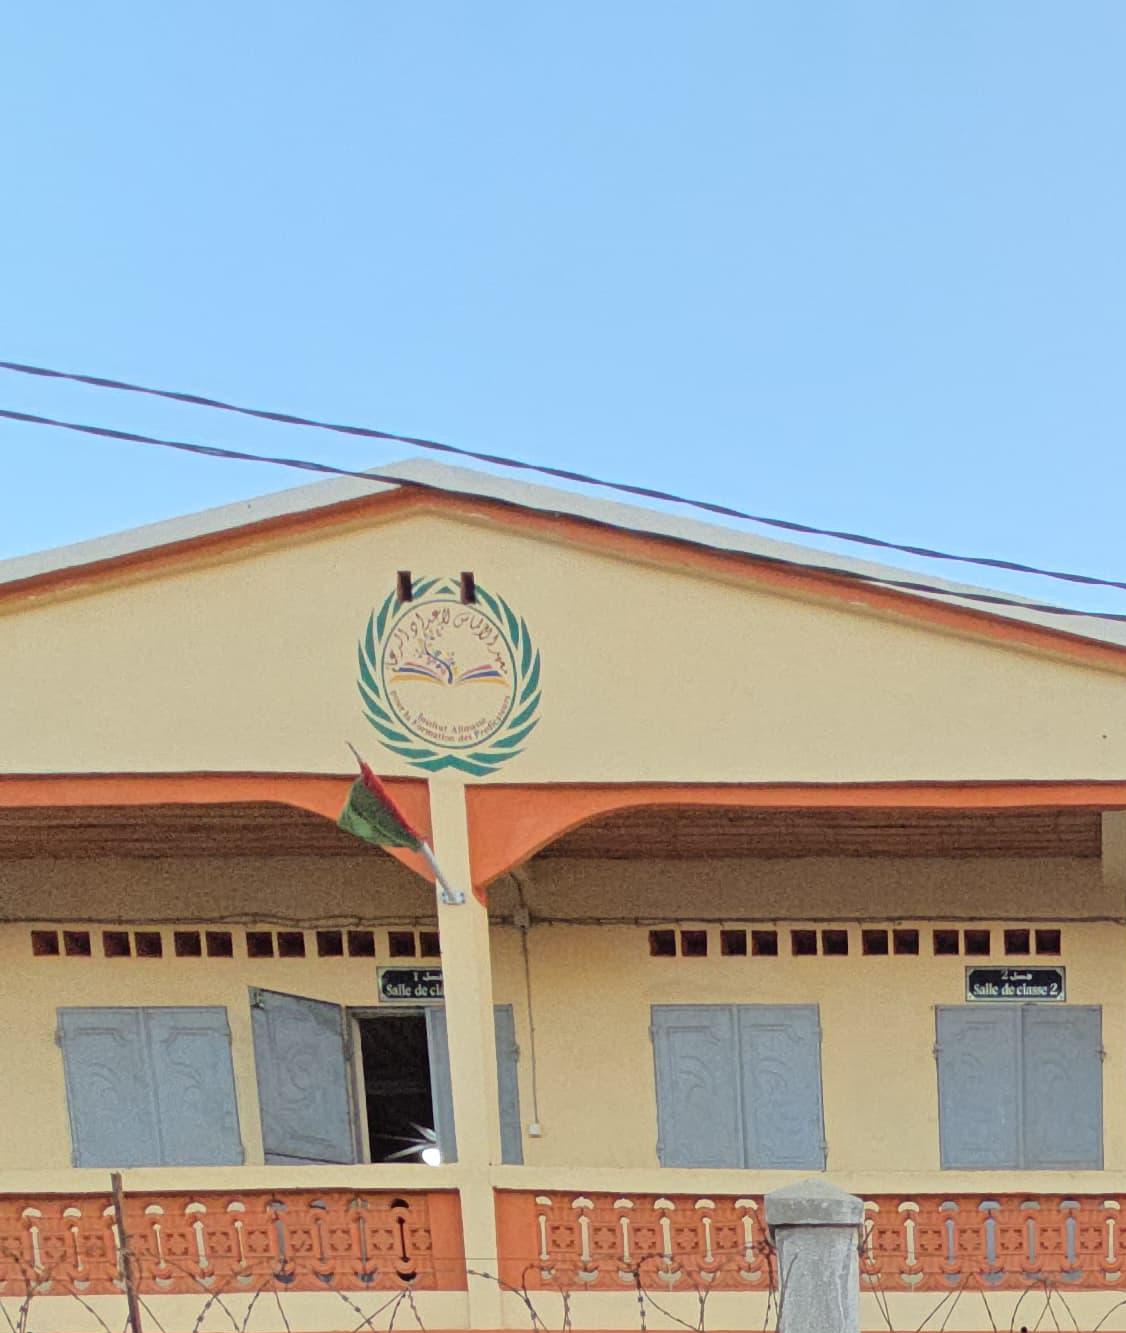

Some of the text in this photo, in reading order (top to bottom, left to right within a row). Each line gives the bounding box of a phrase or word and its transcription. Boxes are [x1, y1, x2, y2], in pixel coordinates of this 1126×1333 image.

[386, 983, 412, 997] Salle
[414, 983, 428, 997] de
[973, 982, 1058, 996] Salle de classe 2
